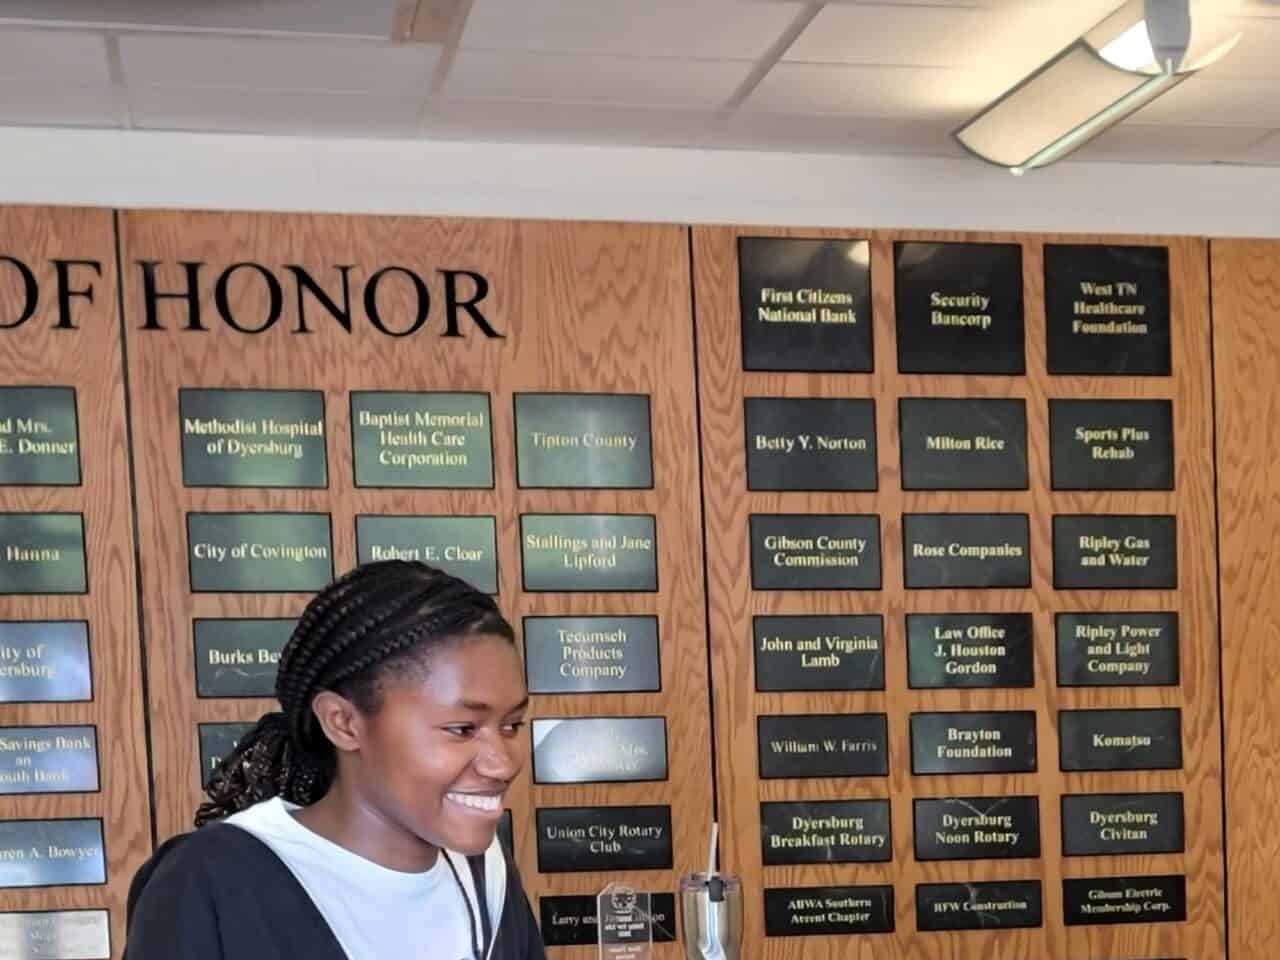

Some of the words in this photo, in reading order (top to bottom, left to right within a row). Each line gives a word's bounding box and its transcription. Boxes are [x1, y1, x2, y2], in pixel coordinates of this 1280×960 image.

[1081, 282, 1112, 295] West
[1116, 283, 1137, 295] TN
[0, 256, 102, 331] OF
[135, 260, 507, 339] HONOR
[761, 289, 793, 303] First
[797, 289, 852, 304] Citizens
[931, 292, 989, 308] Security
[758, 308, 816, 323] National
[821, 309, 856, 323] Bank
[1074, 302, 1145, 315] Healthcare
[931, 311, 991, 329] Bancorp
[1073, 320, 1147, 334] Foundation
[17, 418, 52, 433] Mrs.
[359, 411, 410, 428] Baptist
[415, 411, 483, 428] Memorial
[184, 419, 256, 434] Methodist
[262, 419, 323, 438] Hospital
[1075, 427, 1118, 443] Sports
[1122, 428, 1150, 441] Plus
[381, 431, 427, 446] Health
[431, 432, 465, 446] Care
[533, 432, 579, 449] Tipton
[583, 433, 637, 450] County
[756, 435, 794, 452] Betty
[799, 435, 813, 449] Y.
[817, 436, 866, 449] Norton
[926, 436, 971, 450] Milton
[976, 436, 1005, 449] Rice
[19, 440, 75, 454] Donner
[207, 438, 224, 454] of
[228, 439, 302, 458] Dyersburg
[1092, 446, 1134, 459] Rehab
[380, 451, 467, 469] Corporation
[526, 534, 587, 552] Stallings
[592, 535, 616, 549] and
[620, 535, 651, 550] Jane
[765, 536, 813, 550] Gibson
[817, 536, 865, 552] County
[1079, 536, 1120, 552] Ripley
[1124, 536, 1149, 549] Gas
[6, 546, 60, 561] Hanna
[194, 544, 227, 562] City
[231, 543, 248, 558] of
[251, 544, 327, 562] Covington
[372, 546, 420, 560] Robert
[425, 548, 440, 560] E.
[444, 546, 483, 560] Cloar
[913, 543, 944, 556] Rose
[949, 544, 1022, 559] Companies
[564, 553, 616, 571] Lipford
[774, 553, 859, 567] Commission
[1081, 554, 1105, 566] and
[1109, 554, 1149, 566] Water
[558, 629, 626, 643] Tecumseh
[934, 626, 962, 639] Law
[967, 625, 1005, 639] Office
[1076, 625, 1117, 641] Ripley
[1121, 625, 1161, 638] Power
[0, 644, 22, 659] ity
[27, 644, 47, 658] of
[760, 637, 793, 651] John
[797, 637, 820, 650] and
[825, 636, 878, 653] Virginia
[934, 644, 946, 657] J.
[951, 643, 1005, 656] Houston
[1087, 643, 1112, 655] and
[1115, 642, 1149, 656] Light
[209, 650, 253, 664] Burks
[563, 646, 623, 660] Products
[801, 653, 840, 667] Lamb
[0, 662, 56, 678] ersburg
[560, 663, 626, 679] Company
[945, 661, 997, 674] Gordon
[1087, 660, 1150, 674] Company
[948, 728, 1000, 742] Brayton
[1093, 734, 1150, 747] Komatsu
[771, 741, 820, 753] William
[842, 739, 877, 752] Farris
[937, 745, 1012, 758] Foundation
[0, 768, 30, 784] outh
[792, 816, 863, 832] Dyersburg
[943, 814, 1012, 829] Dyersburg
[1090, 811, 1158, 826] Dyersburg
[547, 827, 585, 840] Union
[589, 826, 615, 840] City
[619, 824, 662, 837] Rotary
[936, 831, 969, 844] Noon
[974, 831, 1019, 845] Rotary
[1101, 829, 1147, 840] Civitan
[590, 841, 621, 853] Club
[771, 834, 834, 849] Breakfast
[840, 833, 885, 847] Rotary
[1126, 888, 1163, 898] Electric
[825, 898, 872, 909] Southern
[963, 900, 1027, 912] Construction
[1081, 902, 1141, 914] Membership
[552, 914, 579, 927] Larry
[828, 912, 870, 924] Chapter
